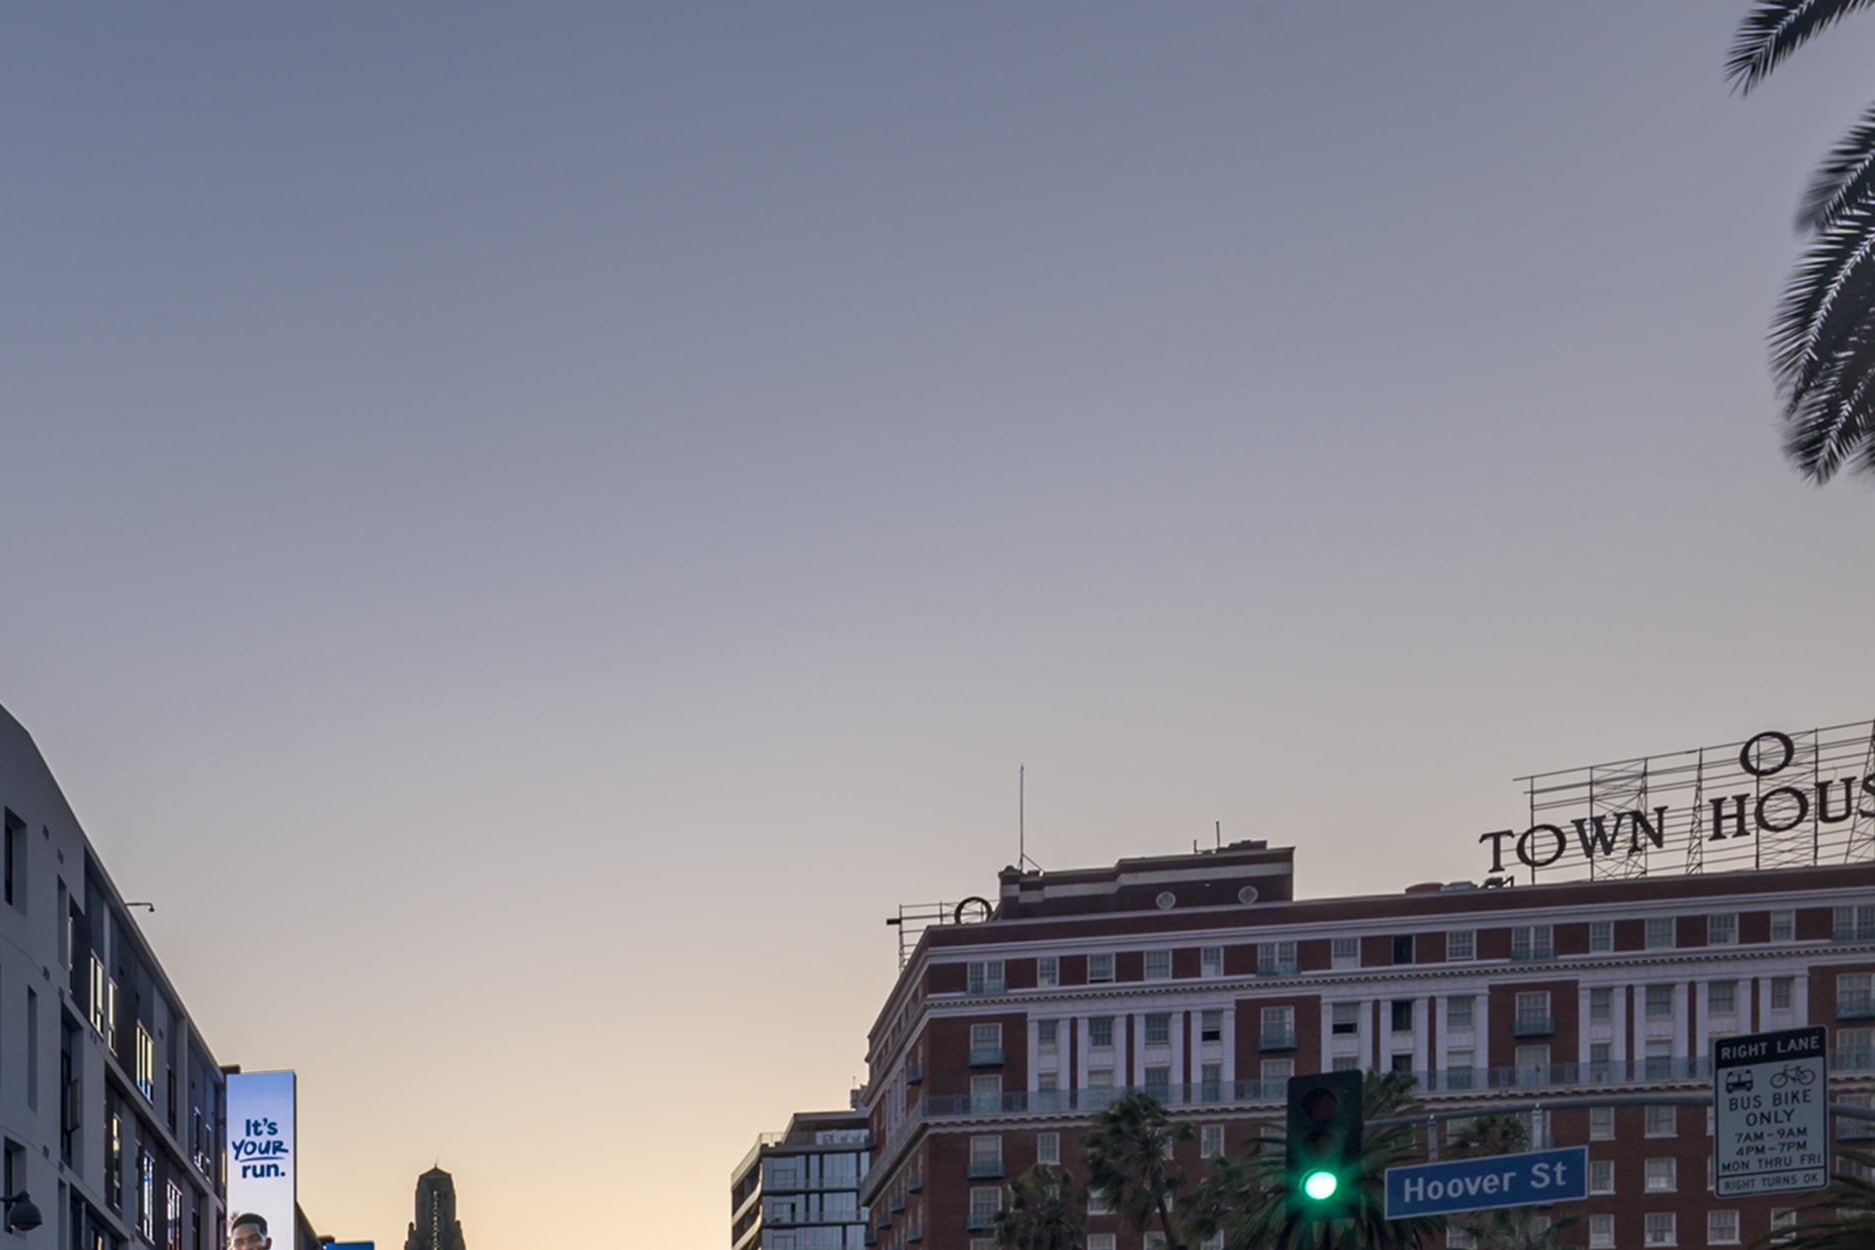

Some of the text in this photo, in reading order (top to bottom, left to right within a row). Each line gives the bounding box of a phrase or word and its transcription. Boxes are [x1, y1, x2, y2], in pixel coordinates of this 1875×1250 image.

[1478, 804, 1669, 873] TOWN
[1720, 1035, 1821, 1061] RIGHT LANE
[1729, 1089, 1812, 1112] BUS BIKE
[245, 1117, 279, 1137] It's
[1745, 1108, 1796, 1127] ONLY
[231, 1138, 289, 1161] YOUR
[241, 1163, 286, 1179] run.
[1721, 1153, 1822, 1173] MON THRU FRI
[1403, 1161, 1567, 1203] Hoover St
[1725, 1172, 1819, 1191] RIGHT TURNS OK
